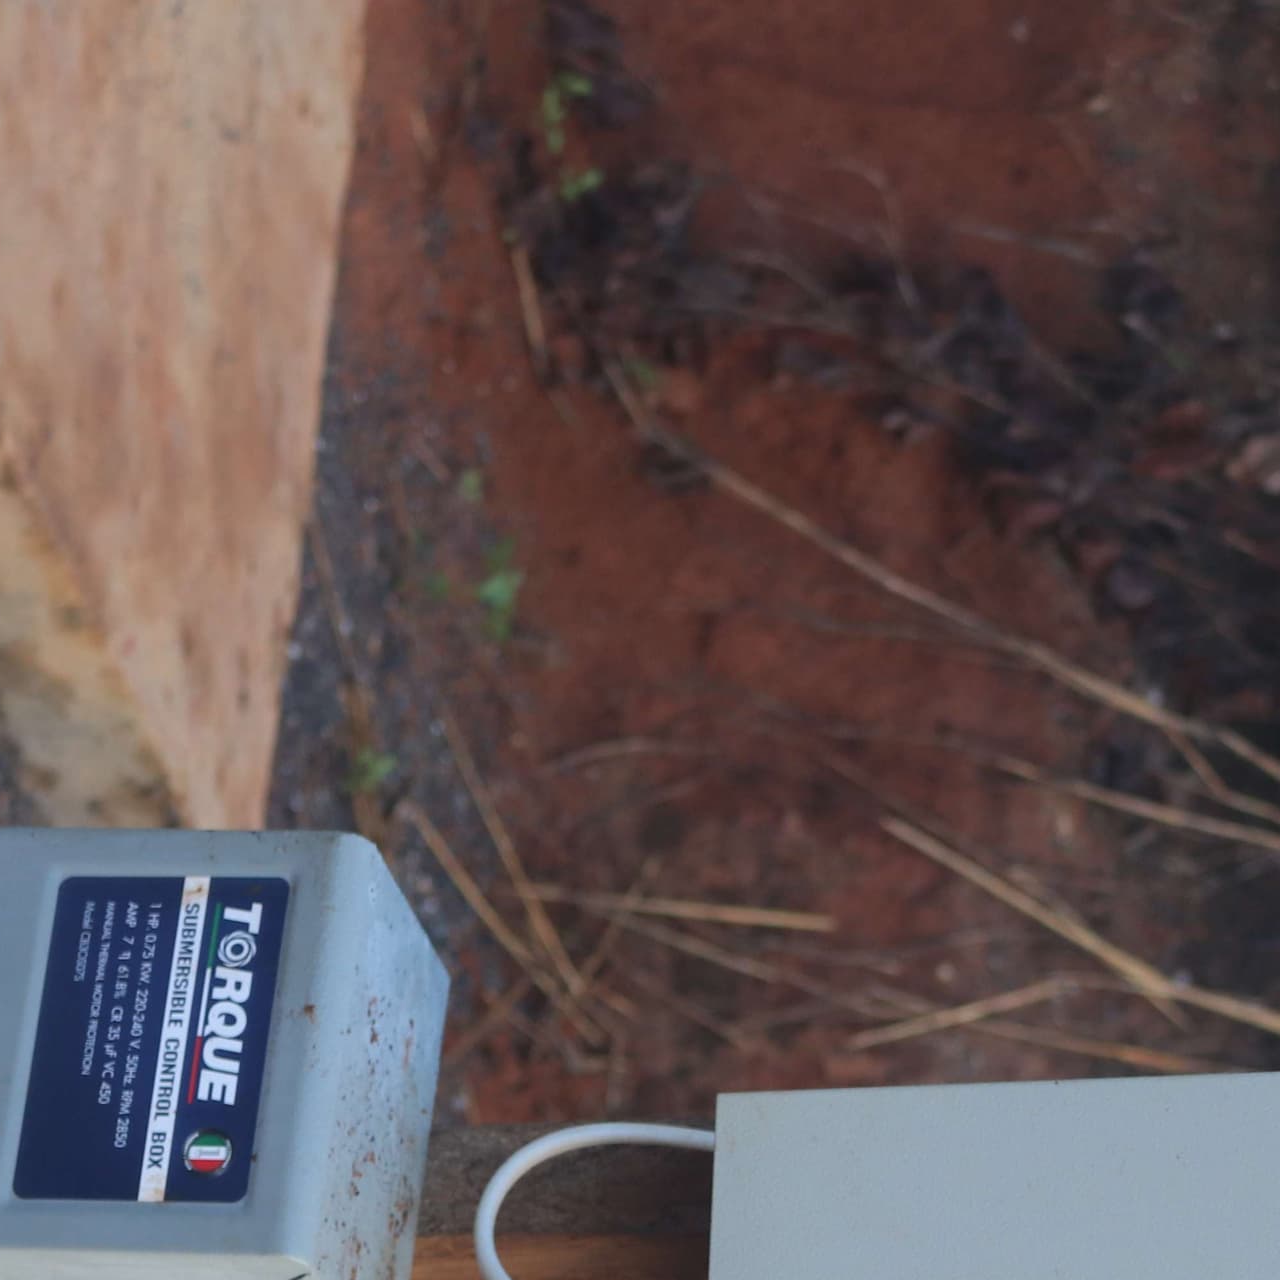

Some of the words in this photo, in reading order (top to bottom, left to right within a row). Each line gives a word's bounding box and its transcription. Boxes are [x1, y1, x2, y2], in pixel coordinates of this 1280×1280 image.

[100, 901, 116, 941] MANUAL
[124, 902, 139, 928] AMP
[123, 935, 134, 944] 7
[94, 943, 111, 982] THERMAL
[168, 903, 201, 1027] SUBMERSIBLE
[111, 1007, 124, 1024] CR
[130, 989, 149, 1037] 220-240
[197, 902, 263, 1105] TORQUE
[80, 1019, 99, 1075] PROTECTION
[108, 1026, 122, 1040] 35
[101, 1061, 115, 1079] VC
[154, 1038, 180, 1120] CONTROL
[97, 1081, 113, 1104] 450
[119, 1090, 135, 1115] RPM
[113, 1118, 131, 1148] 2850
[147, 1132, 166, 1170] BOX
